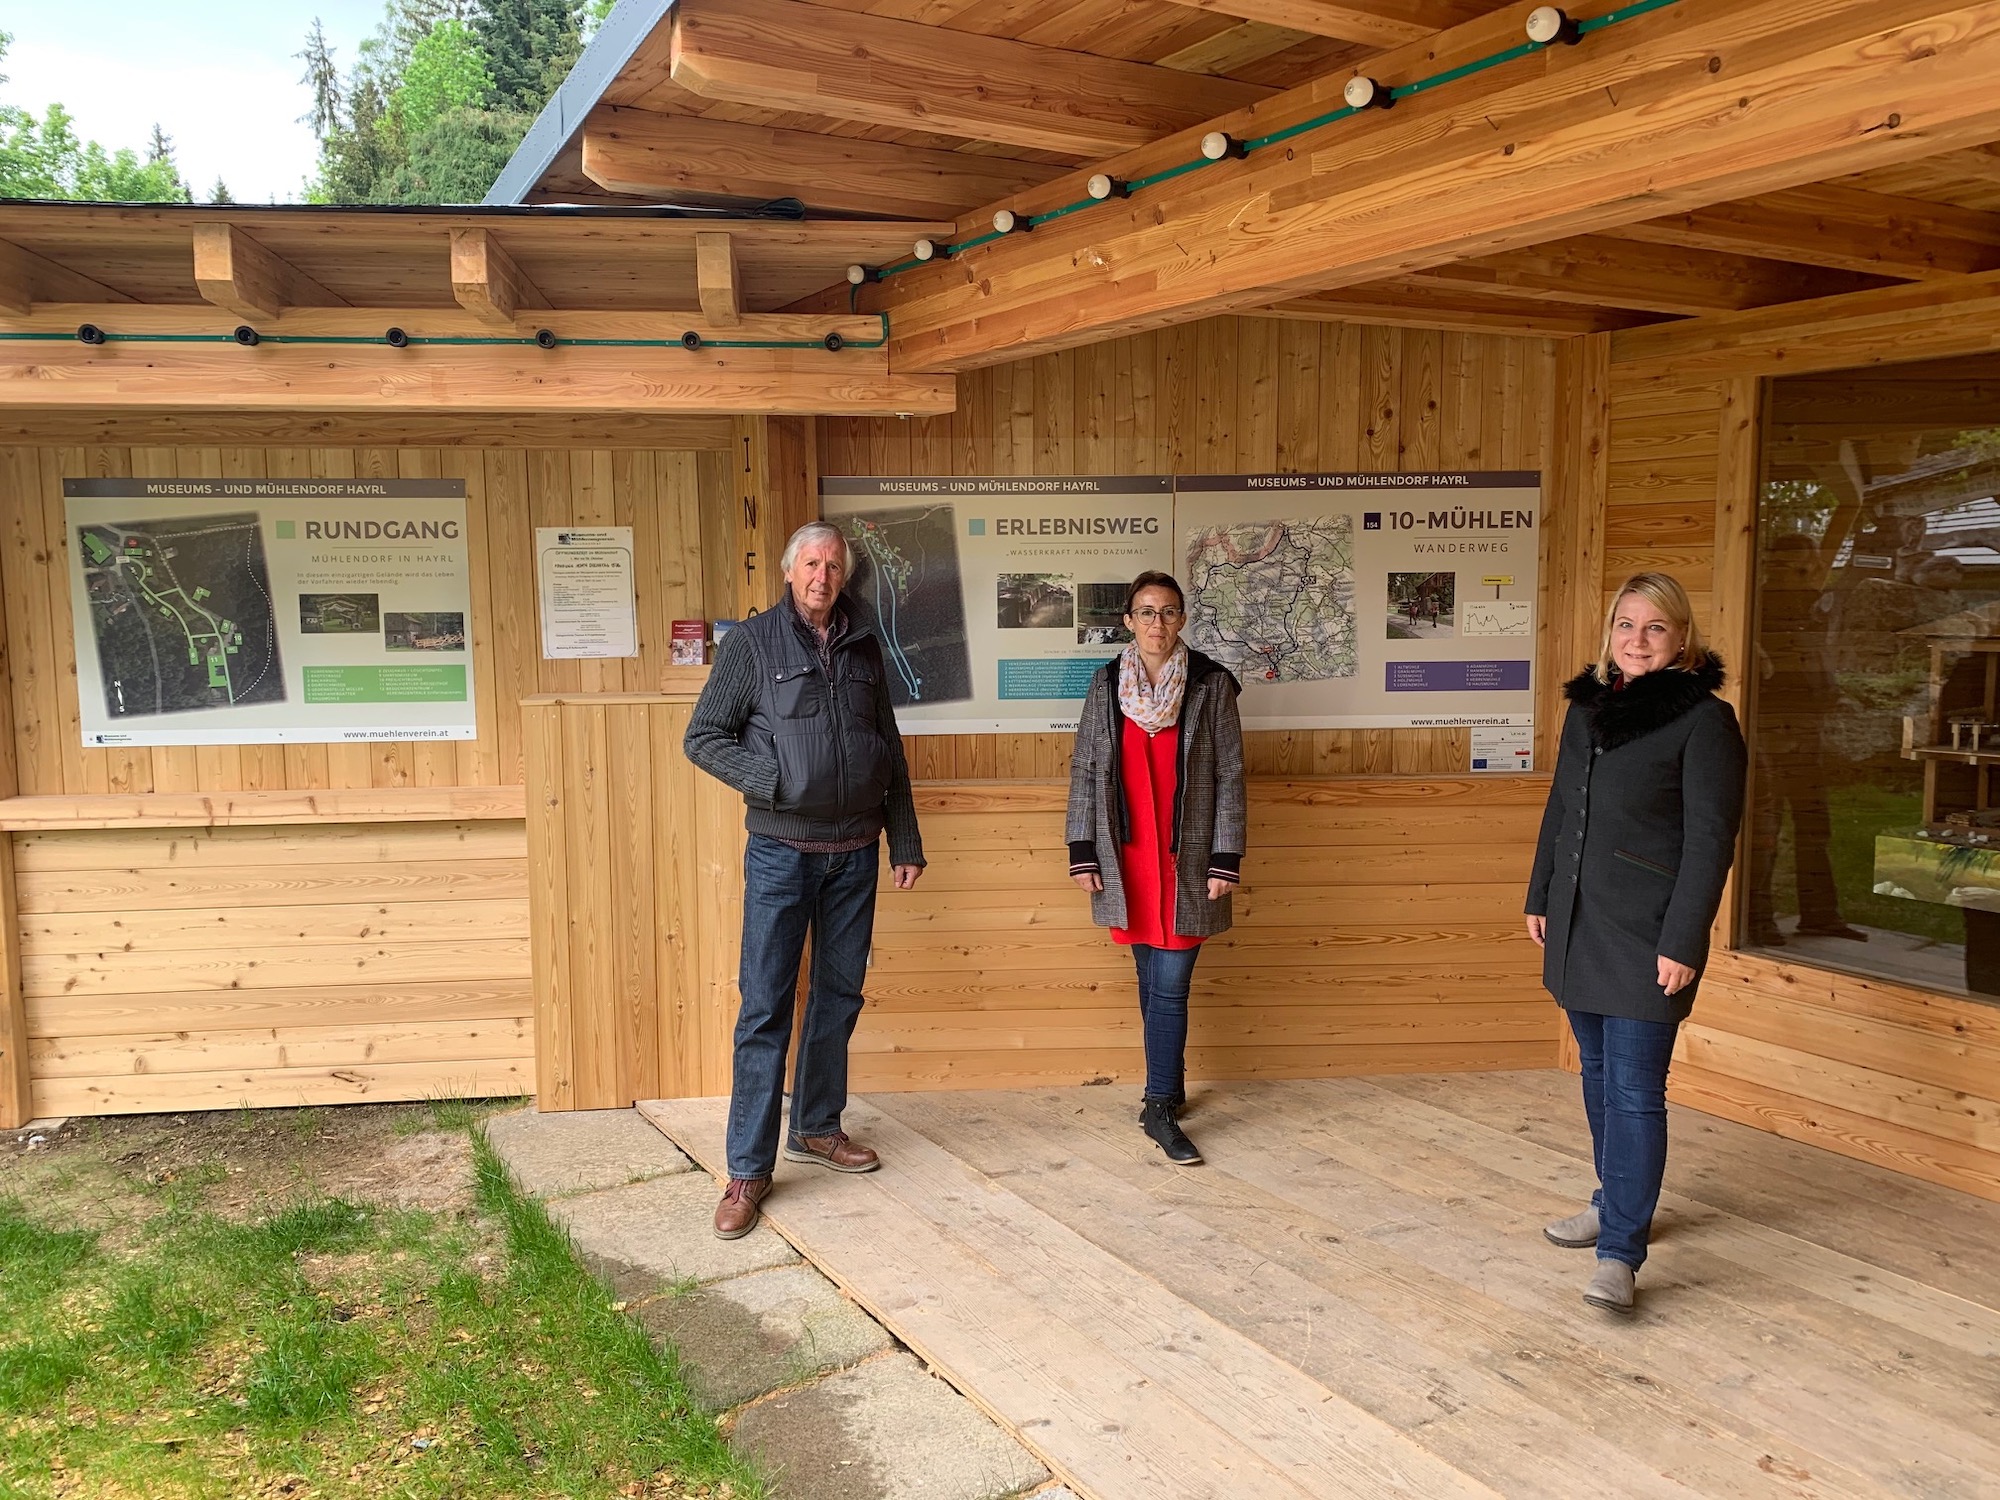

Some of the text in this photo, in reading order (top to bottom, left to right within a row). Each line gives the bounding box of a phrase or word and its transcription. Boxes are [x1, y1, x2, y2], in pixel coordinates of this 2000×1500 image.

[879, 482, 939, 492] MUSEUMS
[950, 482, 975, 492] UND
[979, 480, 1060, 491] MÜHLENDORF
[1063, 482, 1099, 491] HAYRL
[1248, 477, 1306, 487] MUSEUMS
[1318, 477, 1344, 487] UND
[1347, 475, 1429, 486] MÜHLENDORF
[1432, 476, 1469, 485] HAYRL
[147, 484, 212, 494] MUSEUMS
[224, 485, 252, 494] UND
[256, 482, 344, 494] MÜHLENDORF
[347, 485, 387, 494] HAYRL
[1390, 506, 1533, 529] 10-MÜHLEN
[305, 521, 459, 539] RUNDGANG
[996, 518, 1158, 535] ERLEBNISWEG
[1414, 543, 1509, 553] WANDERWEG
[311, 554, 454, 563] MÜHLENDORF IN HAYRL
[1411, 717, 1509, 725] www.muehlenverein.at
[343, 730, 448, 738] www.muehlenverein.at
